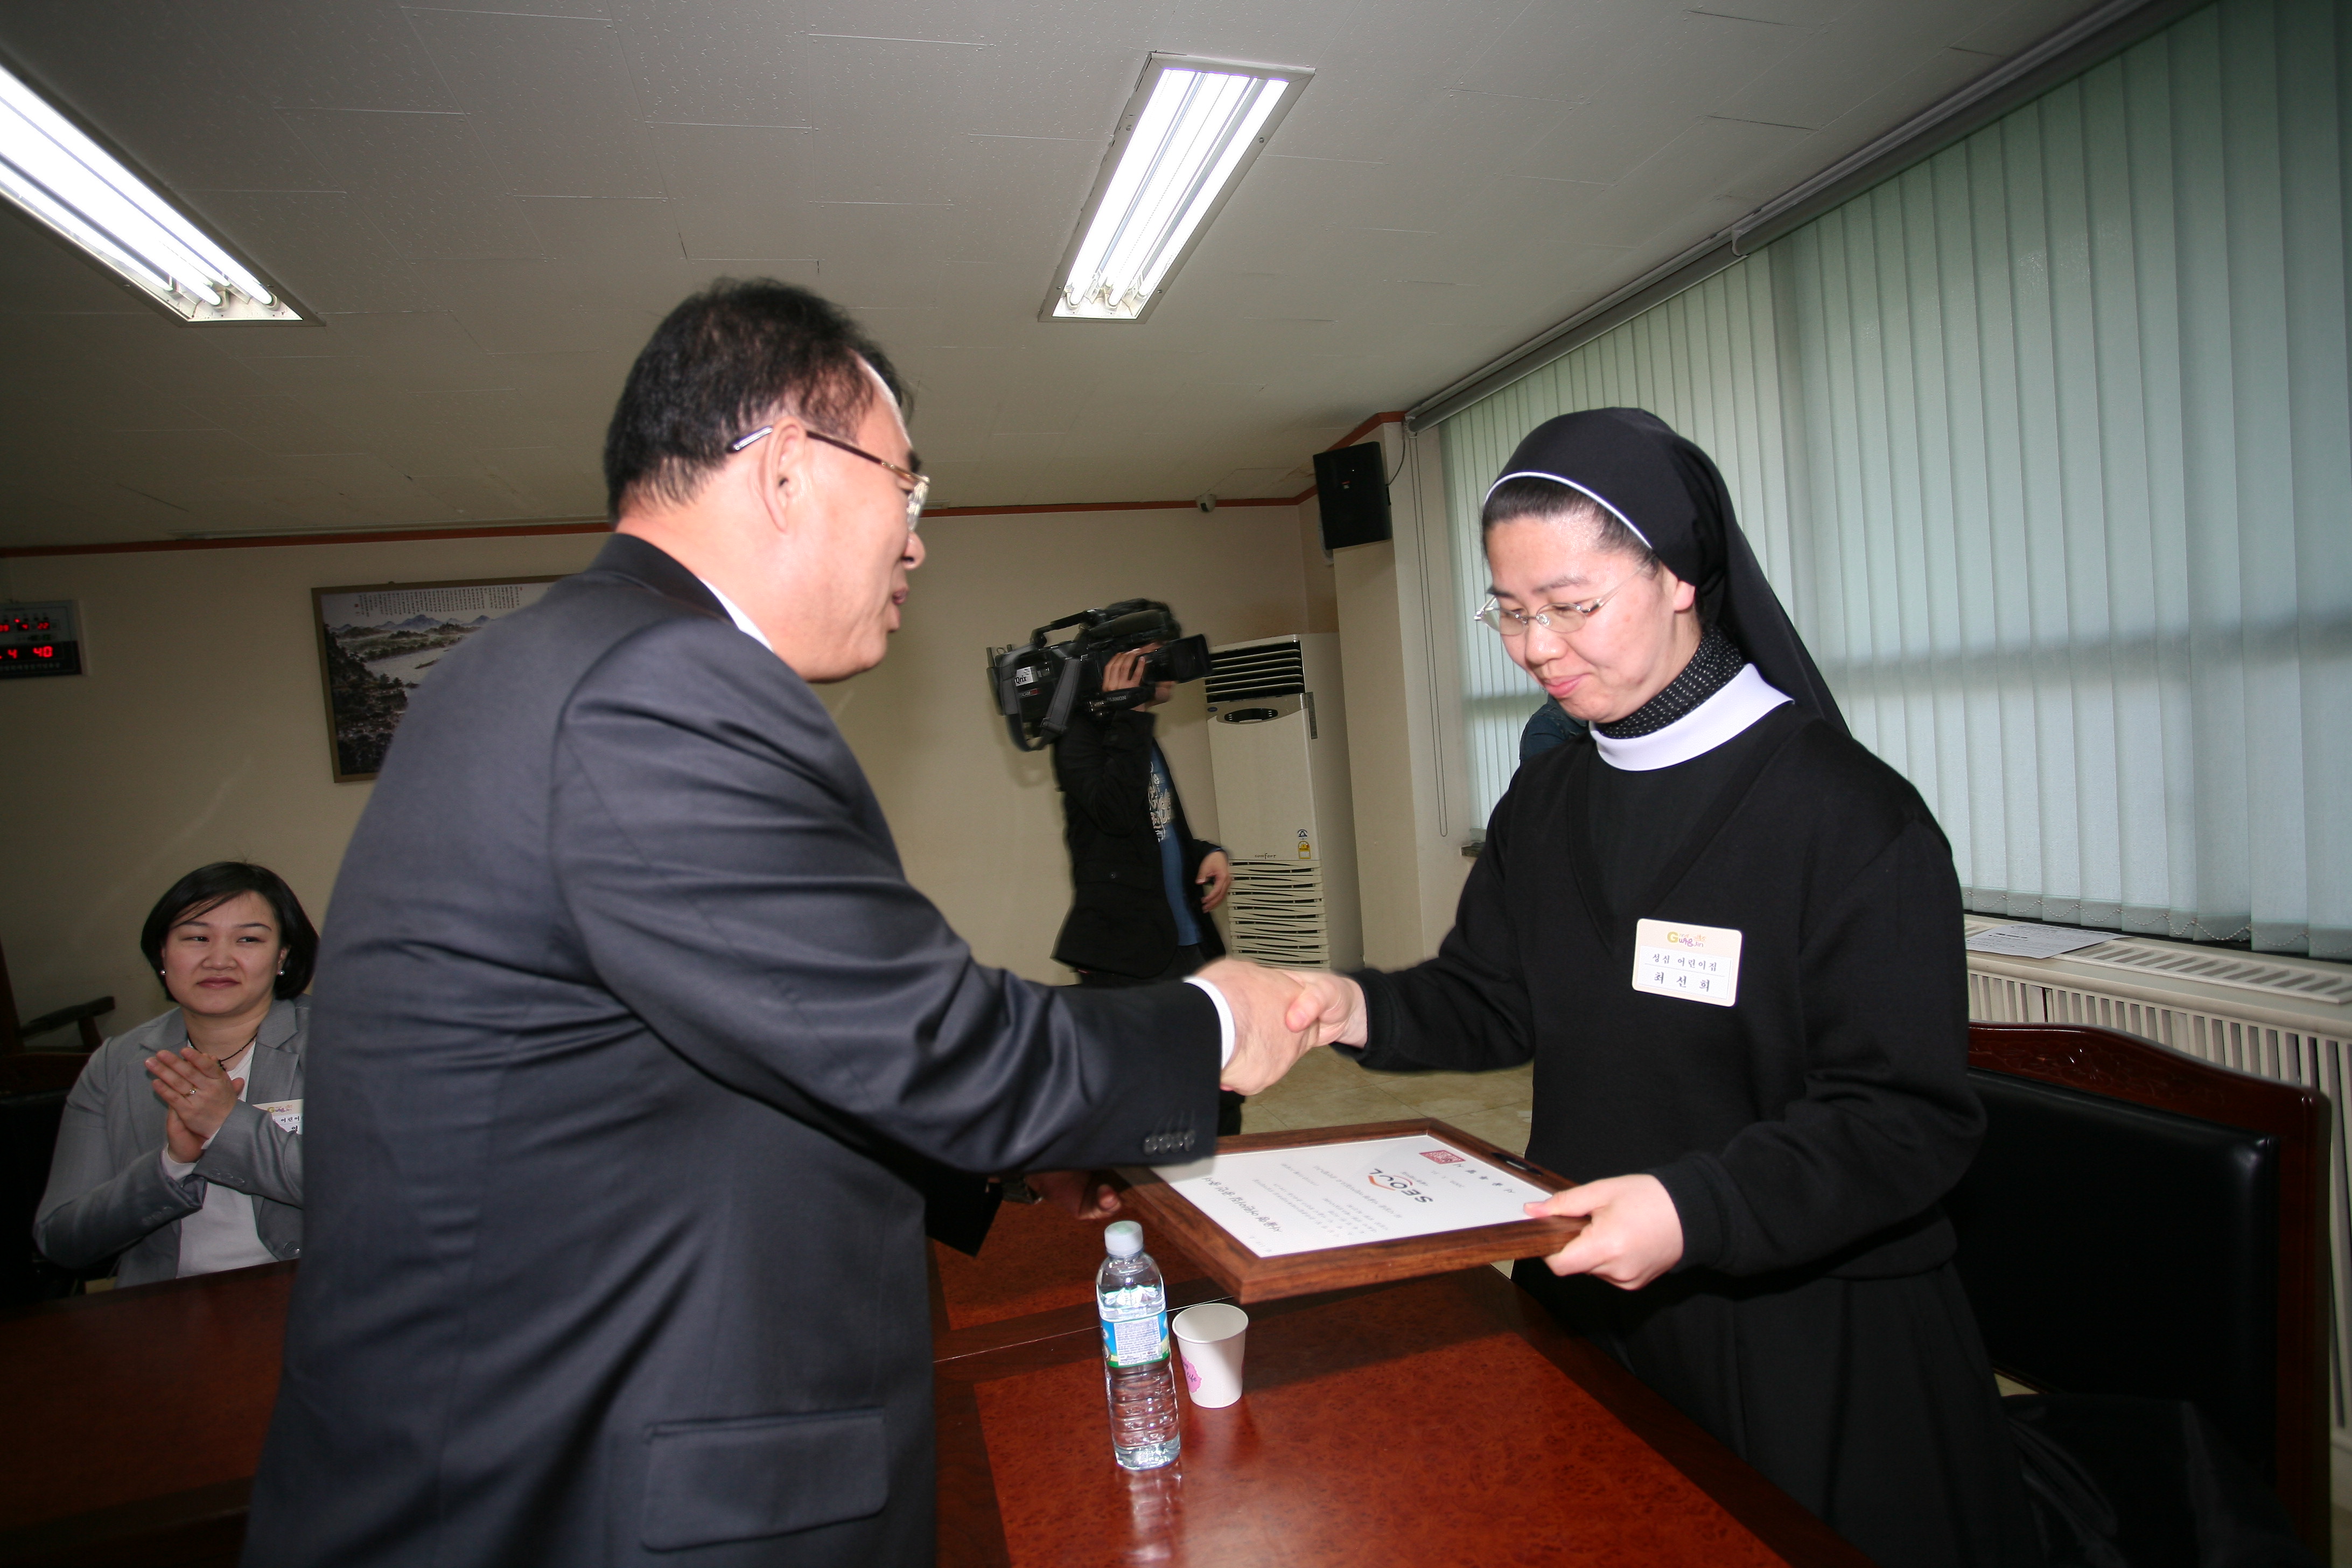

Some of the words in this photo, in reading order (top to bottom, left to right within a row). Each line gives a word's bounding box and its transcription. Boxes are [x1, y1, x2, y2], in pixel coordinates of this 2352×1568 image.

[8, 649, 17, 659] 4
[33, 646, 53, 657] 40
[1653, 954, 1670, 964] 성심
[1677, 957, 1717, 972] 어린이집
[1370, 1169, 1432, 1202] SEOUL
